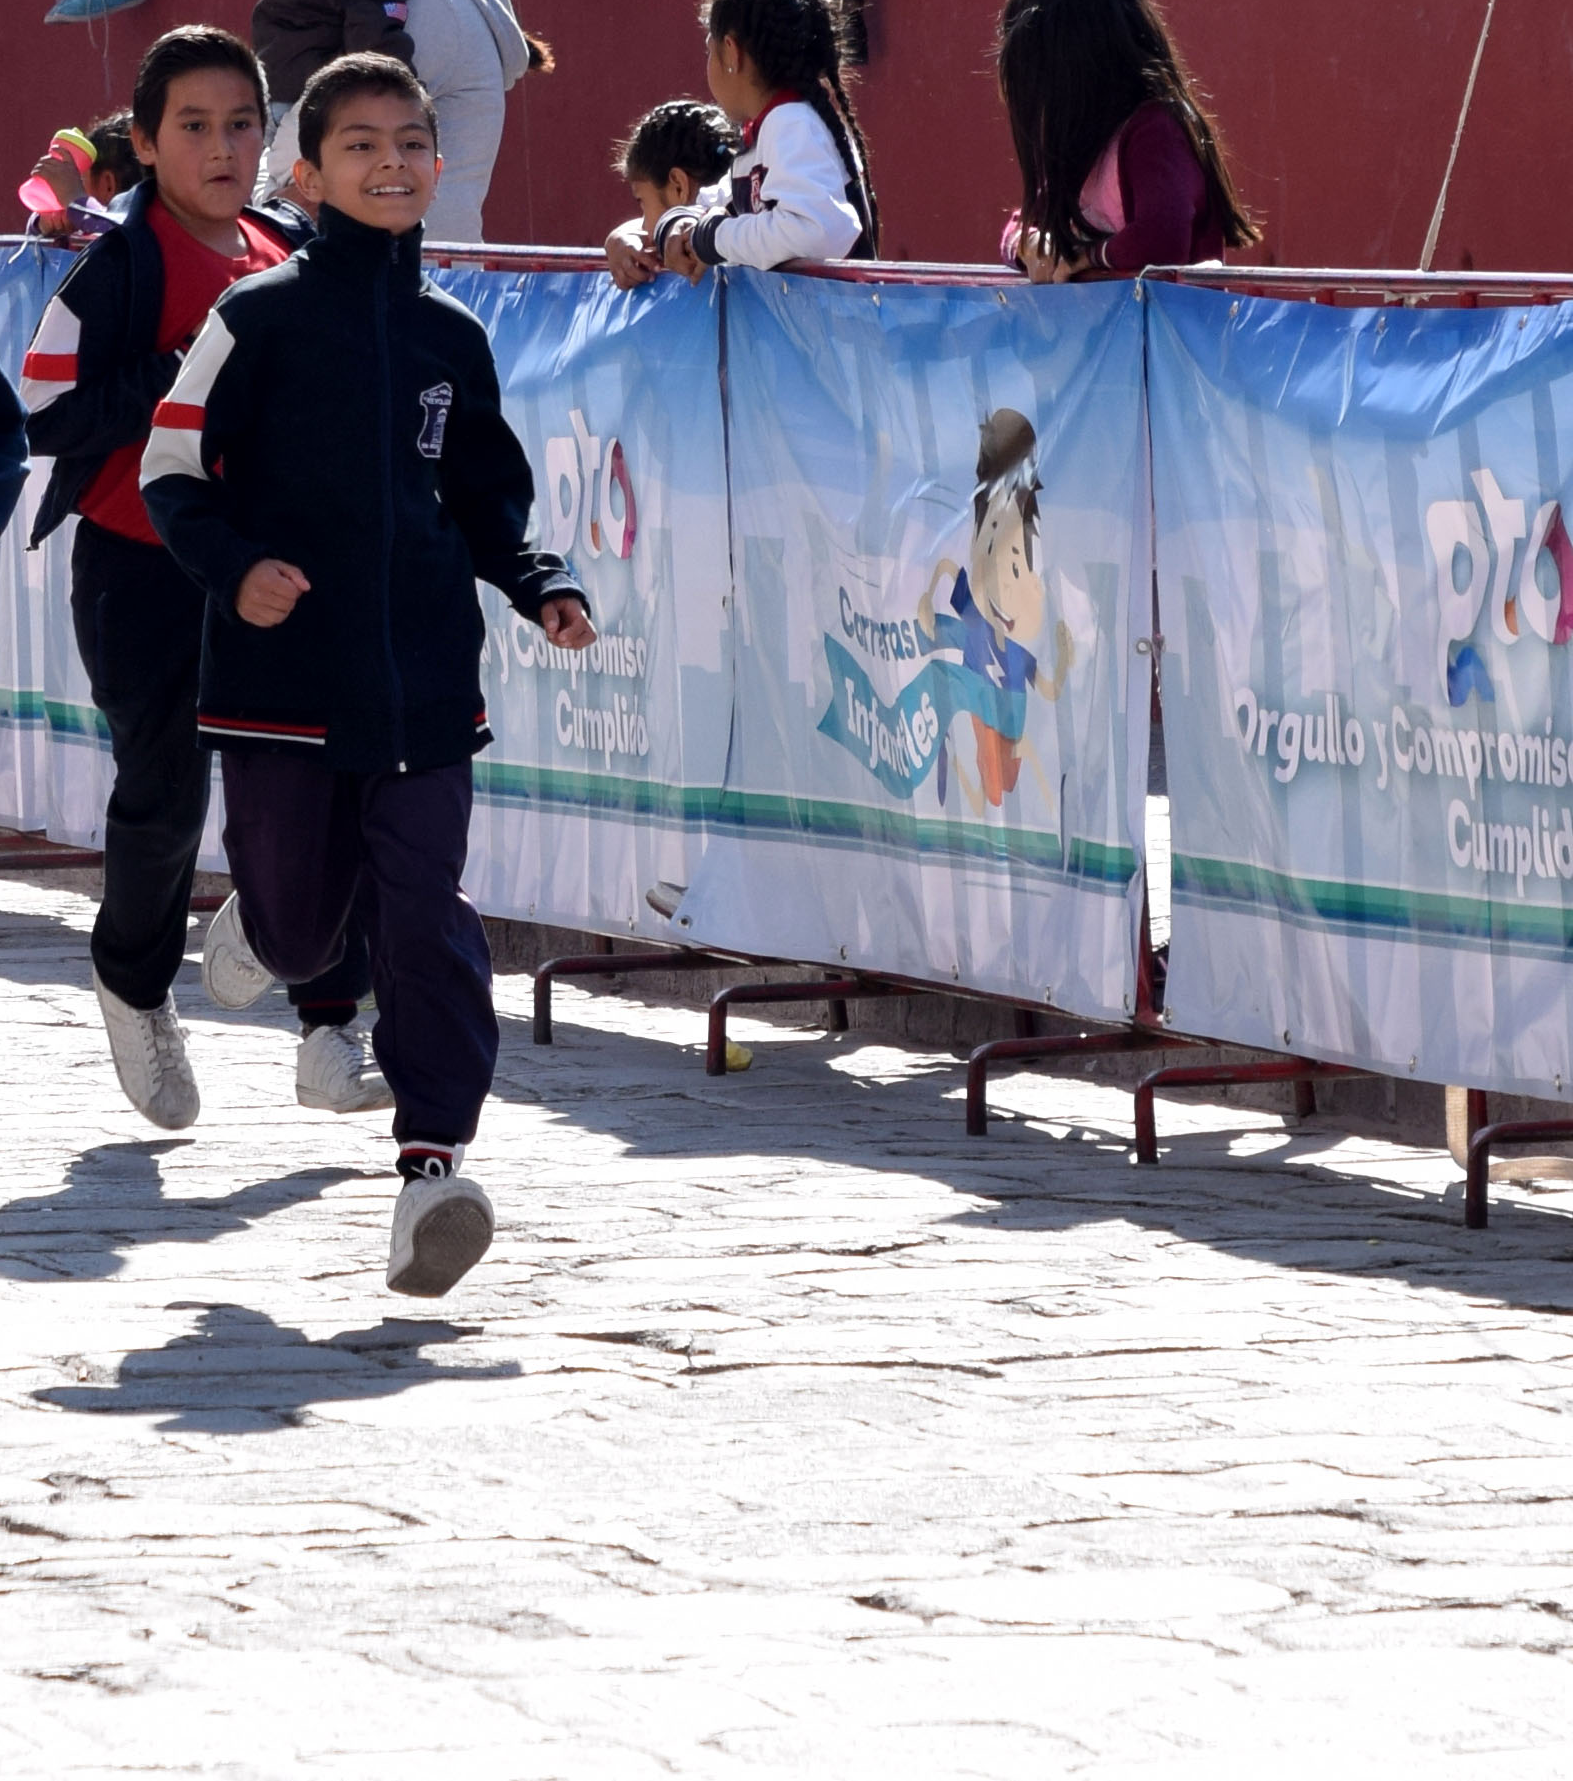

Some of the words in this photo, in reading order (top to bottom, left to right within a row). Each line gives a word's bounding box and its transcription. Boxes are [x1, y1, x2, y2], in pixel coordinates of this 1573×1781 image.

[839, 586, 917, 662] Carreras
[555, 690, 650, 769] Cumplido
[845, 676, 939, 779] Infantiles
[1233, 686, 1365, 784] Orgullo
[1447, 798, 1573, 899] Cumplid
